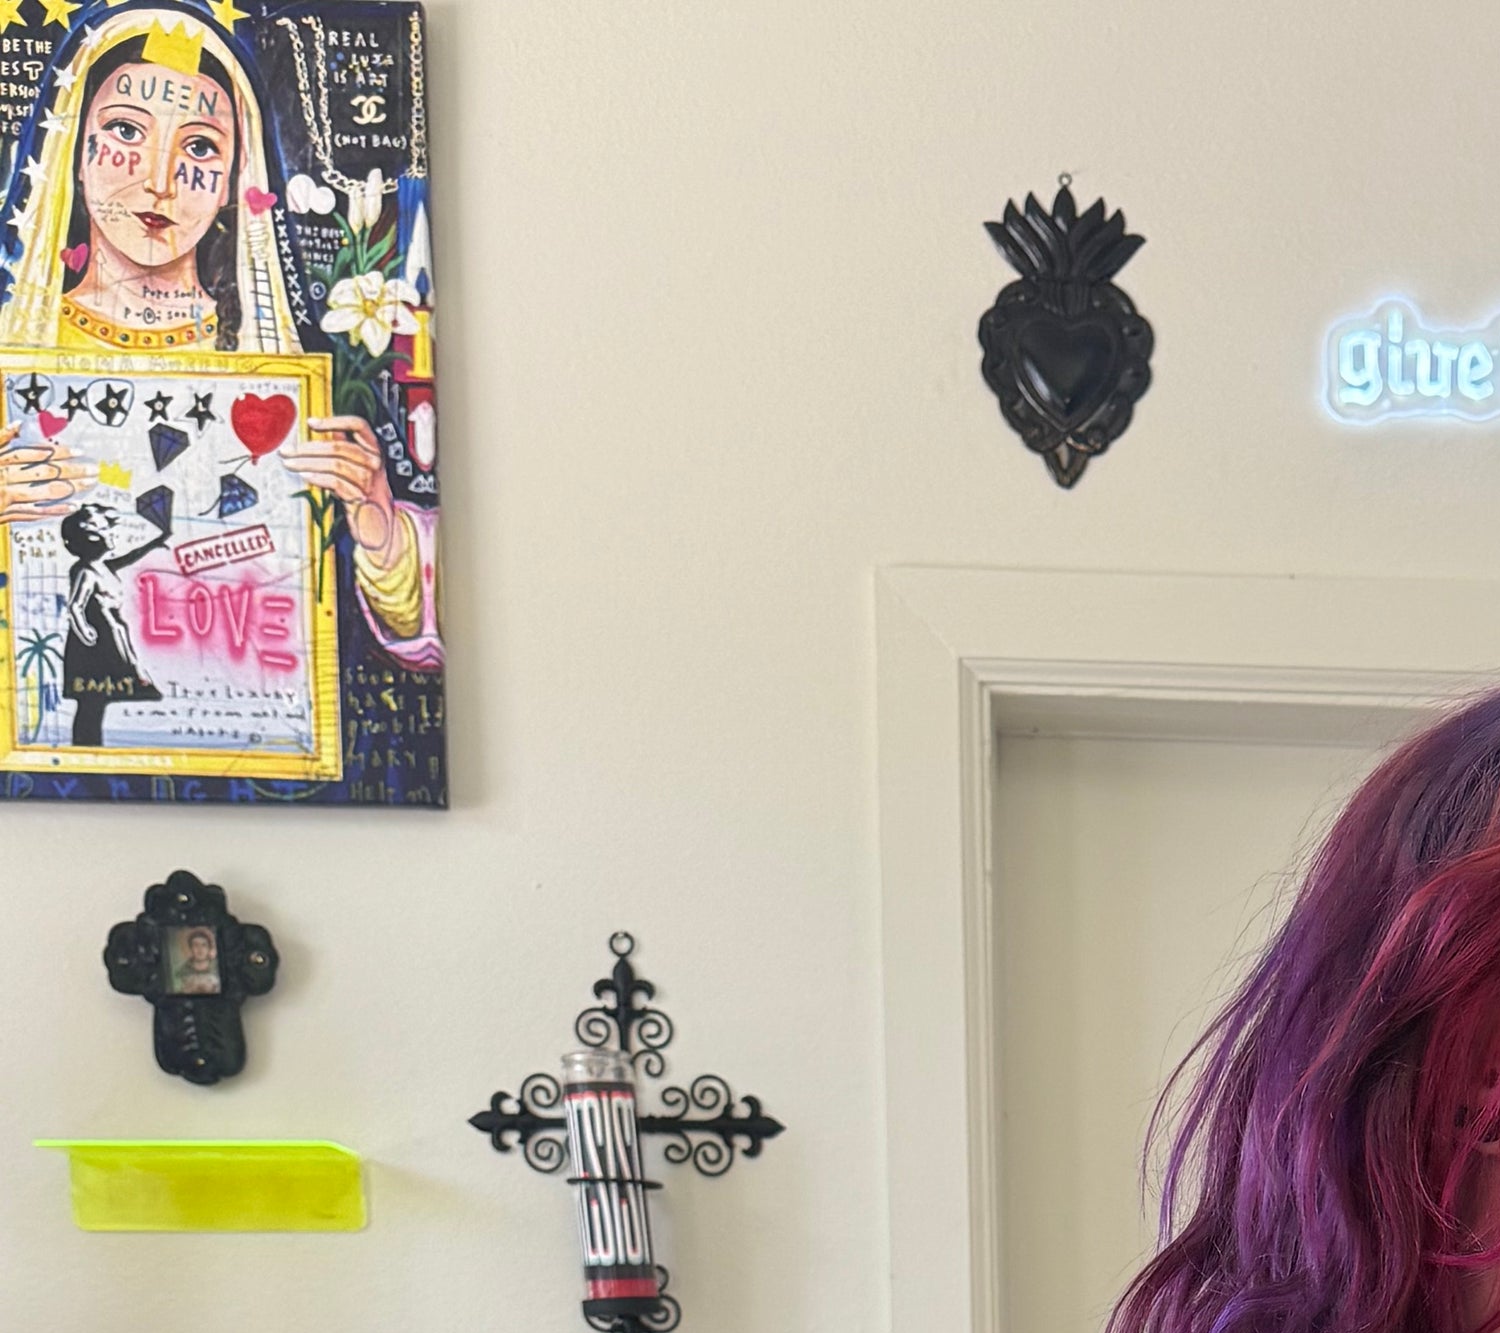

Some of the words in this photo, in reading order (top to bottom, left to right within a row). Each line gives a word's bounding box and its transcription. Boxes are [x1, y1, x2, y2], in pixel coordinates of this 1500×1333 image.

[2, 38, 21, 53] BE
[23, 38, 53, 56] THE
[328, 30, 379, 47] REAL
[0, 60, 44, 81] EST
[333, 70, 348, 84] IS
[355, 73, 389, 87] ART
[117, 73, 219, 116] QUEEN
[97, 147, 141, 176] POP
[173, 163, 224, 194] ART
[1338, 308, 1495, 406] give
[184, 533, 270, 568] CANCELLED
[138, 572, 297, 671] LOVE
